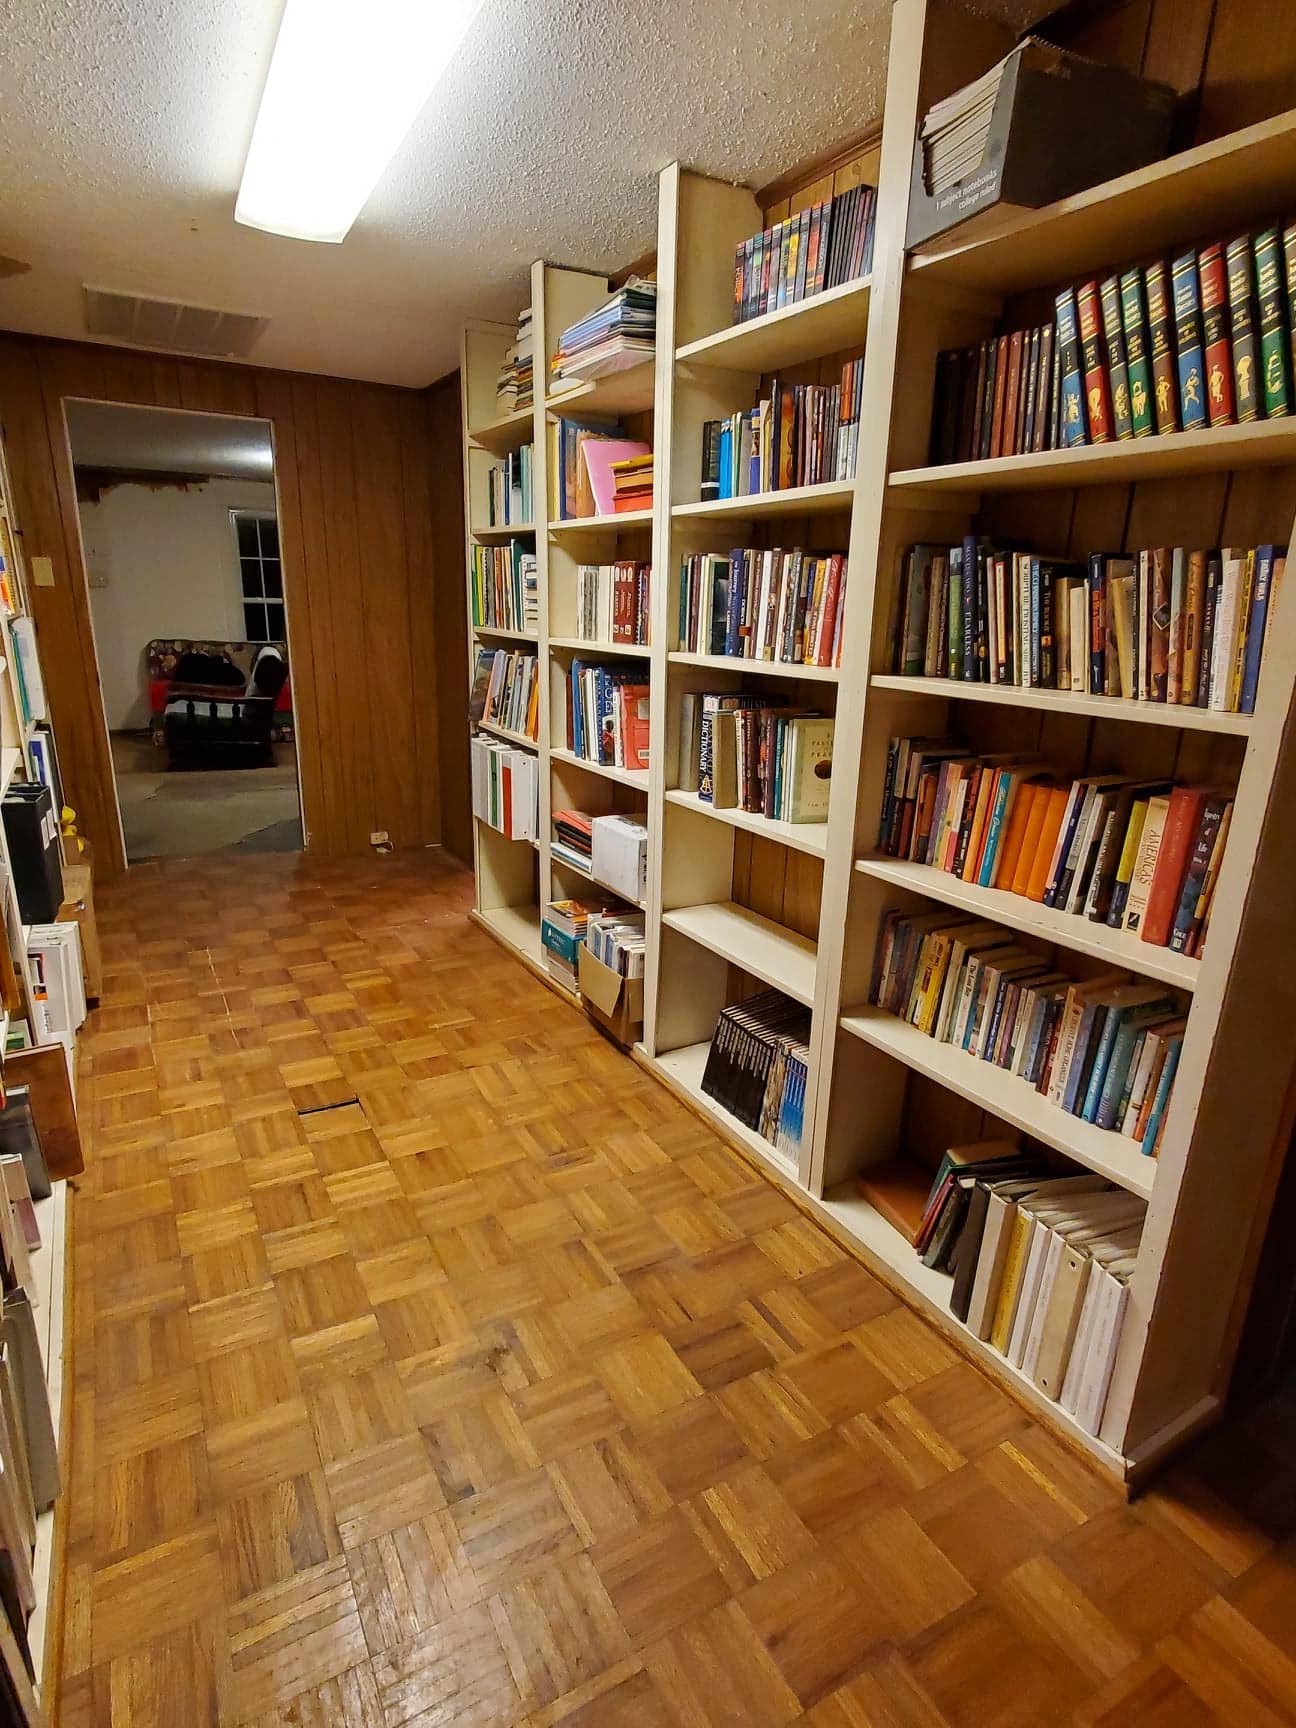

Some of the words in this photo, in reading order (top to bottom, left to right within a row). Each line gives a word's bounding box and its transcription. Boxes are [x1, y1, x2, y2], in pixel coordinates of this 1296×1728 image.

[958, 191, 980, 209] college
[962, 168, 997, 196] notebooks
[964, 611, 972, 656] FEARLESS
[700, 720, 710, 773] DICTIONARY
